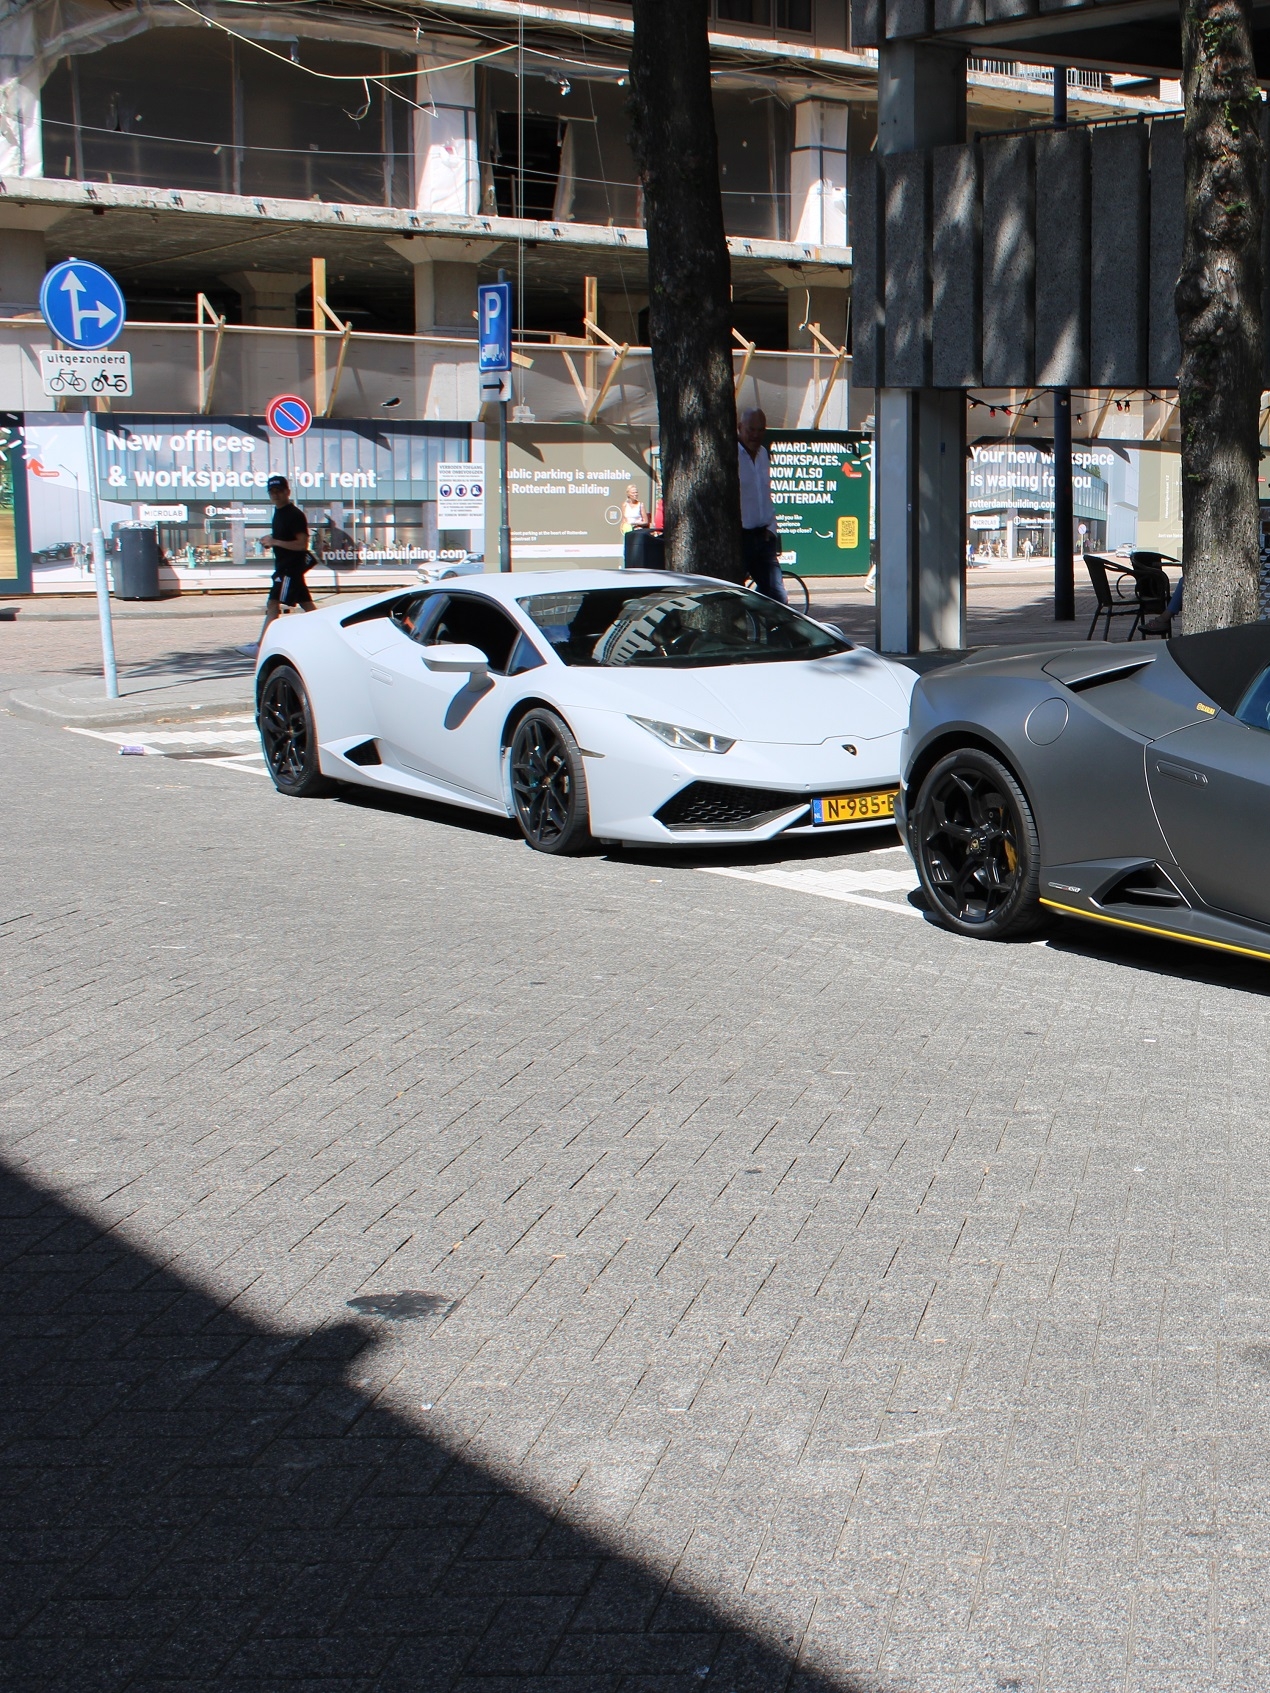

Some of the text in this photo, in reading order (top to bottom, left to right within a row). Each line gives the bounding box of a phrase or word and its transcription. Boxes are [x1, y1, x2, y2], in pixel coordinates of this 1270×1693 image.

[484, 291, 502, 335] P
[47, 354, 126, 366] uitgezonderd
[106, 429, 256, 453] New offices
[770, 441, 853, 454] AWARD-WINNING
[970, 446, 1005, 463] Your
[1008, 450, 1037, 464] new
[108, 464, 128, 487] &
[330, 468, 377, 489] rent
[498, 469, 632, 482] ublic parking is available
[769, 467, 823, 479] NOW ALSO
[769, 480, 837, 491] AVAILABLE IN
[970, 471, 1092, 491] is waiting fo ou
[511, 484, 566, 494] Rotterdam
[568, 484, 610, 497] Building
[770, 492, 834, 504] ROTTERDAM.
[144, 509, 183, 517] MICROLAB
[322, 546, 468, 562] rotterdambuilding.com
[827, 793, 896, 819] N-985-B
